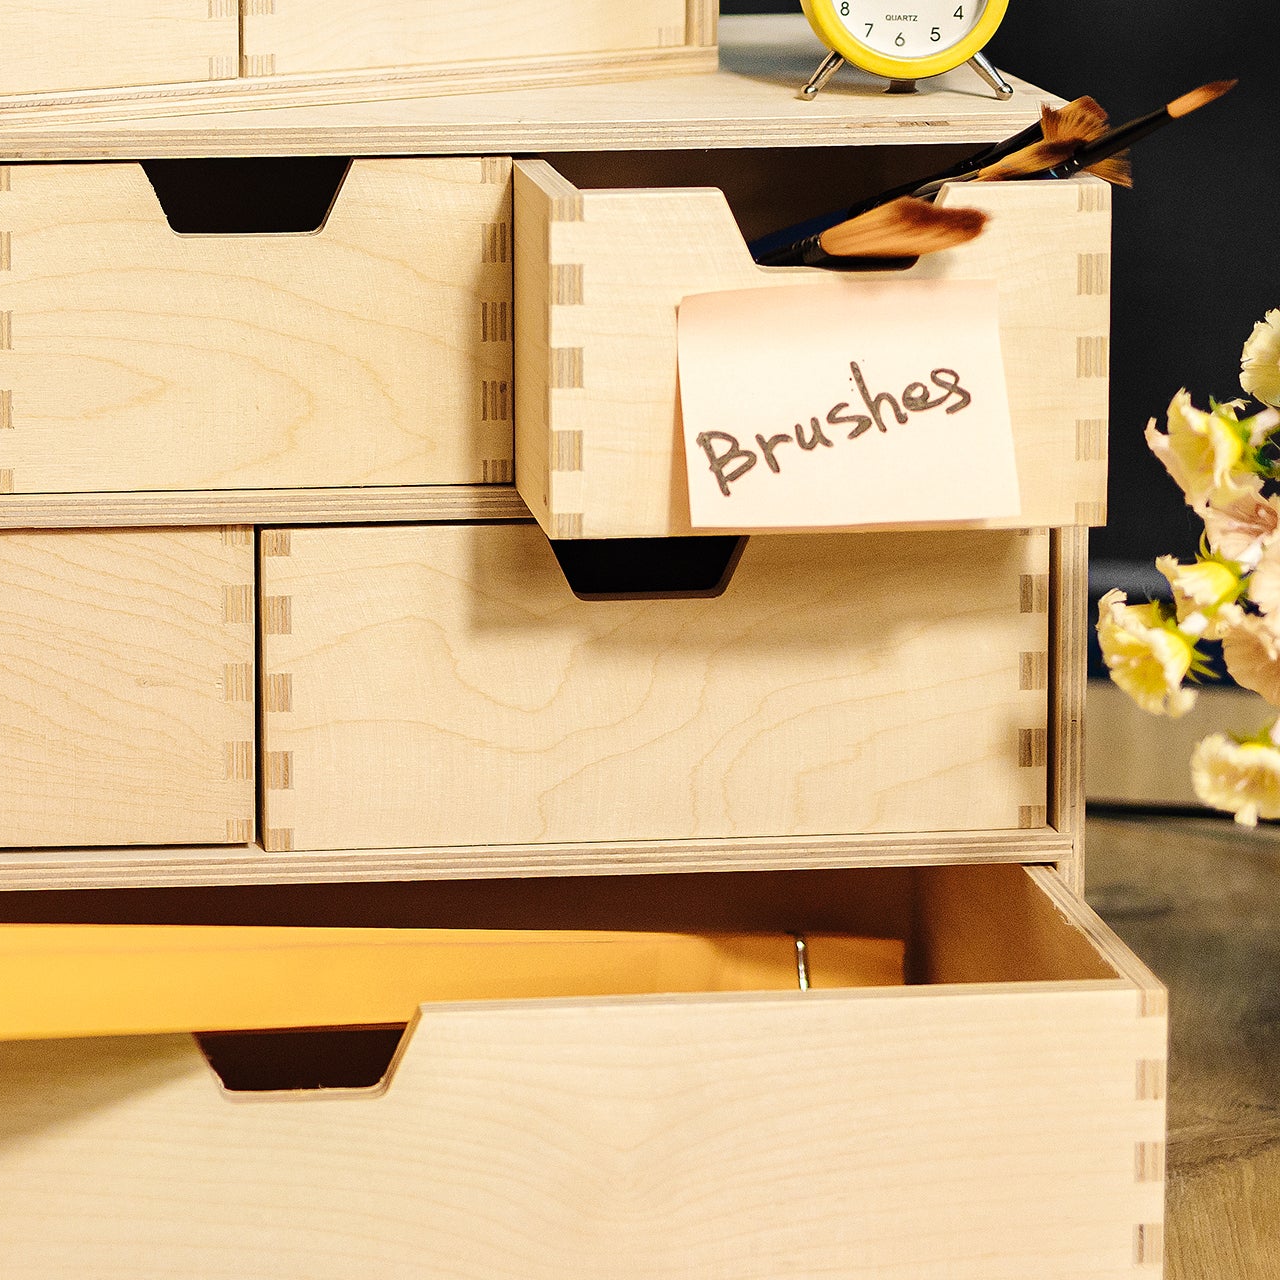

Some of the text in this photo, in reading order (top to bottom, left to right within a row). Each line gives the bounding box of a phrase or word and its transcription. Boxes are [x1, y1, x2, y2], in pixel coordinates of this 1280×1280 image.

[839, 1, 851, 17] 8
[953, 4, 965, 20] 4
[885, 14, 919, 23] QUARTZ
[864, 23, 874, 38] 7
[929, 27, 941, 42] 5
[894, 32, 906, 48] 6
[695, 360, 973, 498] Brushes
